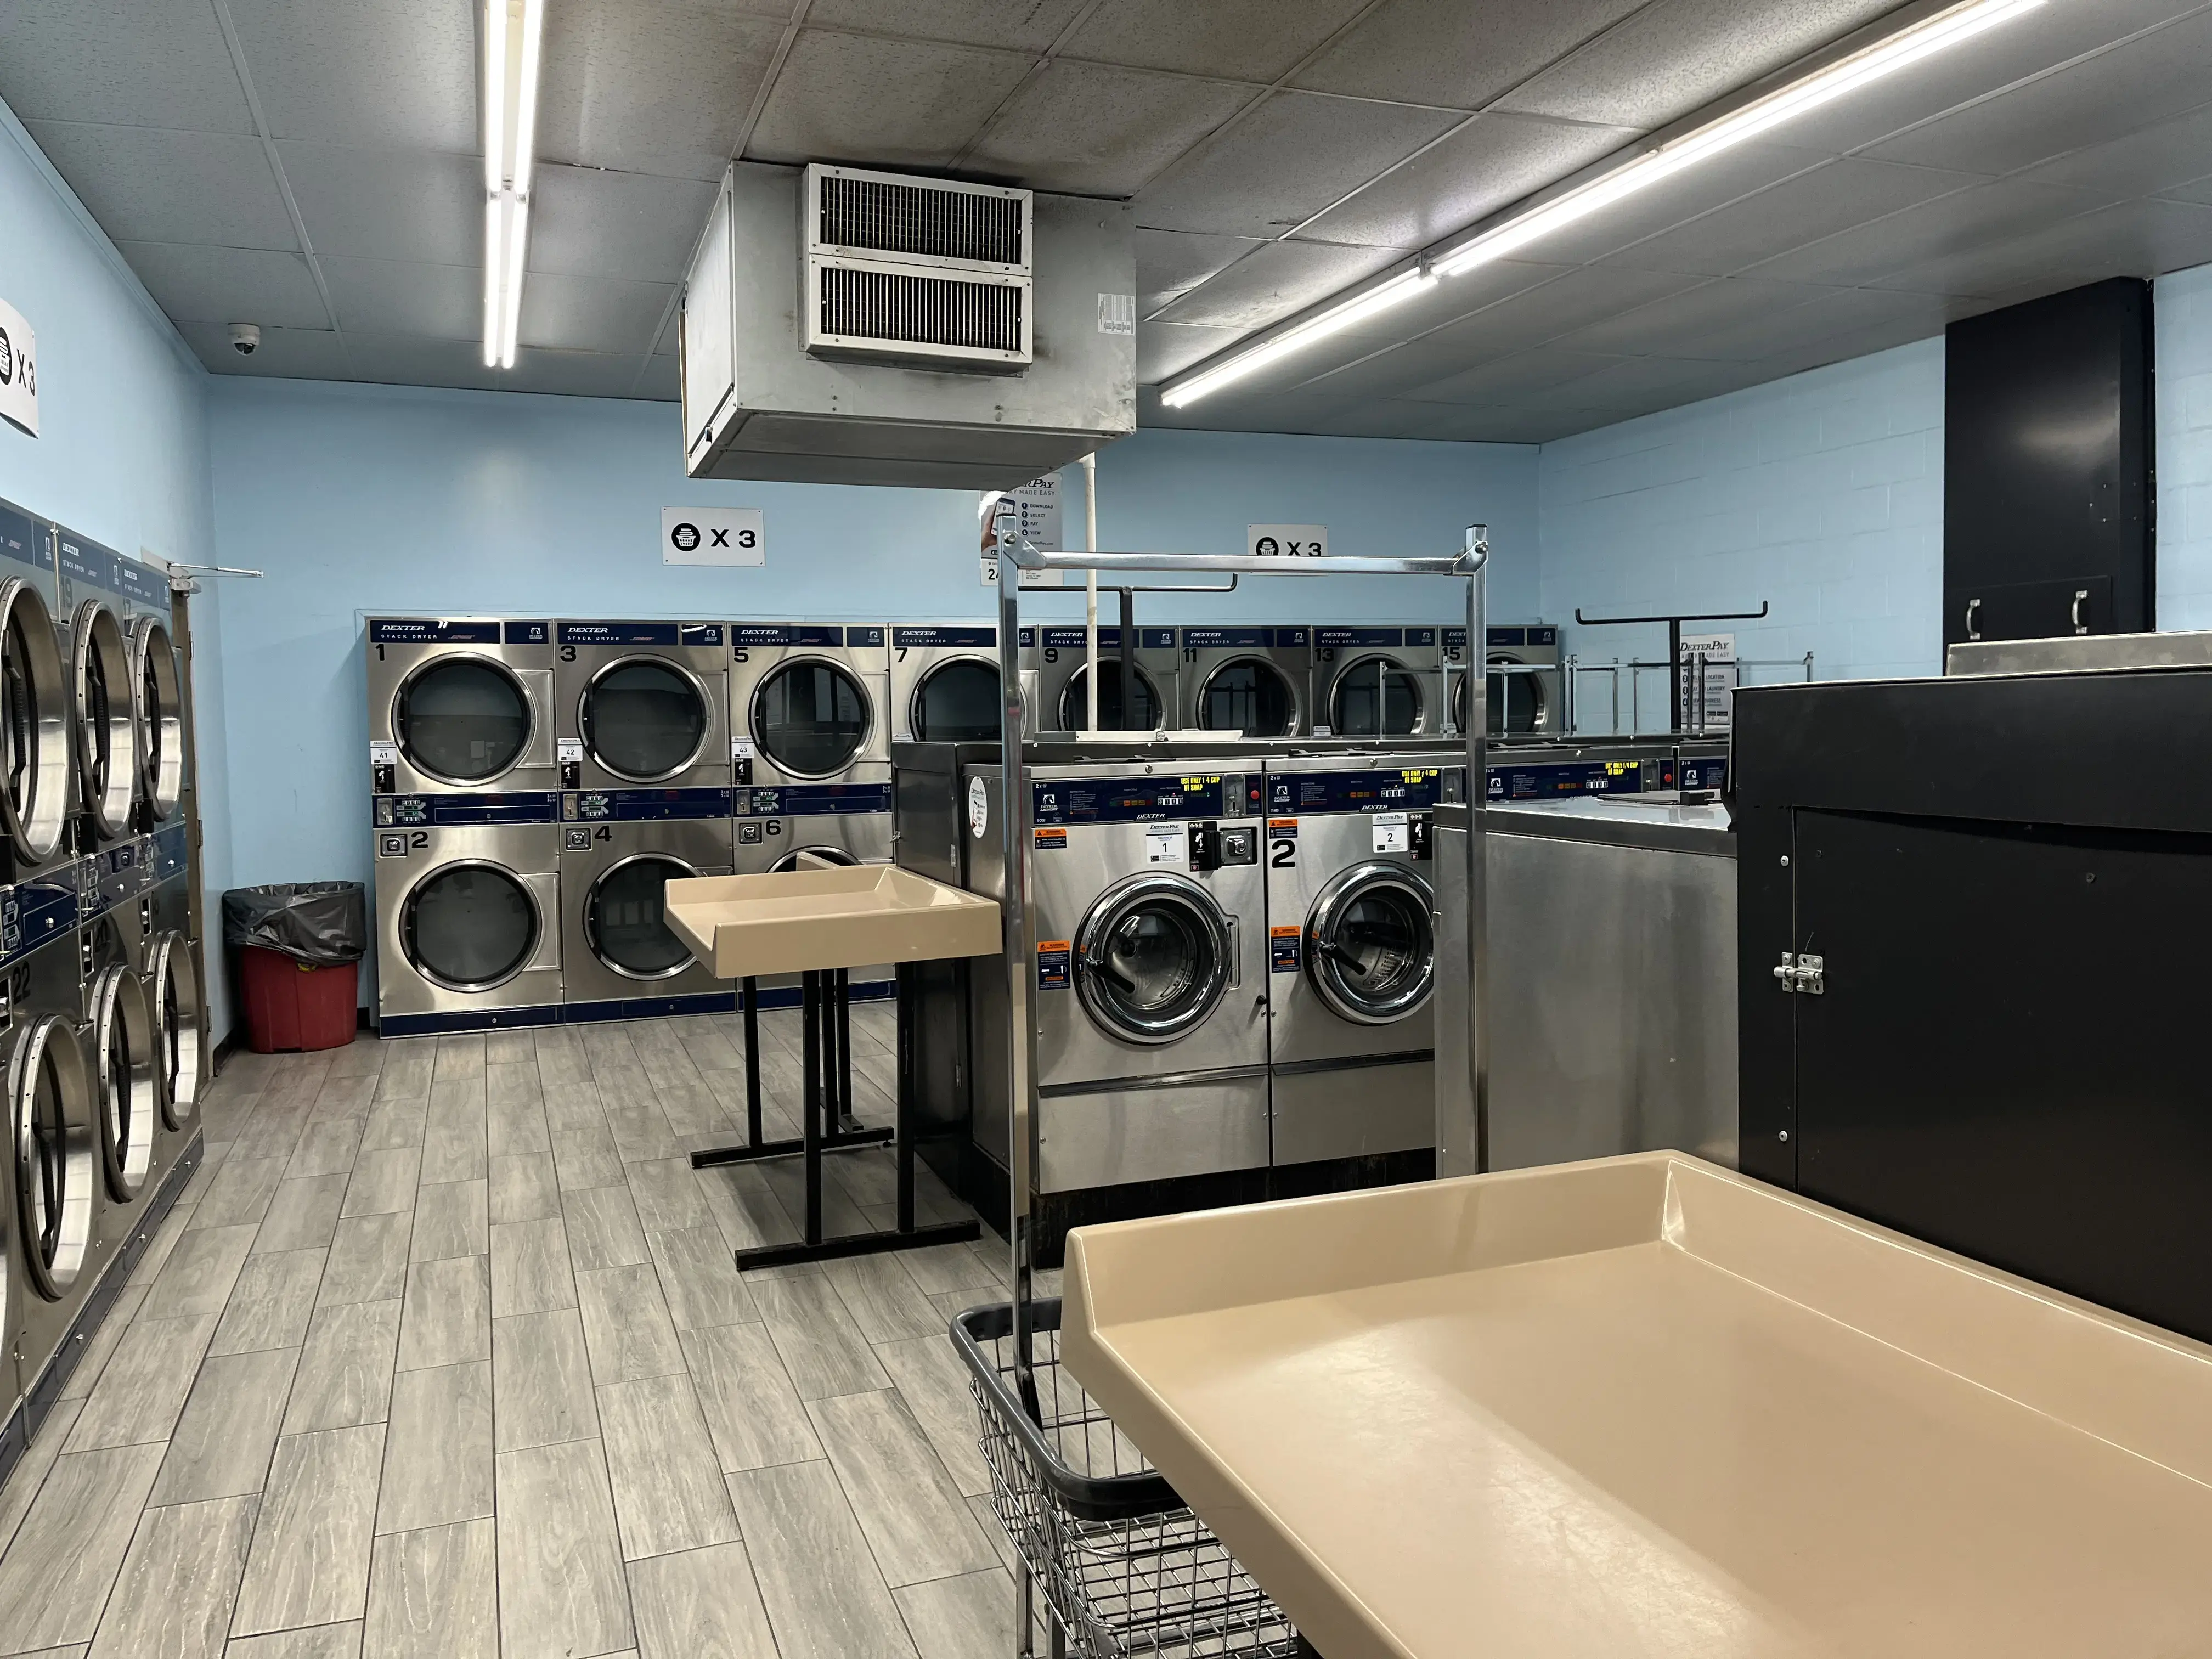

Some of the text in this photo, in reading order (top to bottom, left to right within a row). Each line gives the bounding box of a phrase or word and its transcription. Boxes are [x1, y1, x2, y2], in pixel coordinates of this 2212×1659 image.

[16, 349, 36, 396] X 3
[710, 528, 756, 548] X 3
[63, 542, 80, 557] DEXTER
[1286, 541, 1322, 557] X 3
[988, 568, 998, 580] 2
[375, 644, 385, 661] 1
[560, 645, 577, 662] 3
[733, 647, 749, 663] 5
[894, 647, 908, 663] 7
[1044, 648, 1059, 663] 9
[1182, 648, 1197, 663] 11
[1314, 647, 1334, 662] 13
[1441, 647, 1461, 661] 15
[594, 825, 612, 842] 4
[765, 819, 781, 836] 6
[411, 831, 428, 849] 2
[1387, 833, 1393, 842] 2
[1163, 843, 1167, 853] 1
[1272, 839, 1296, 868] 2
[13, 961, 31, 1005] 22
